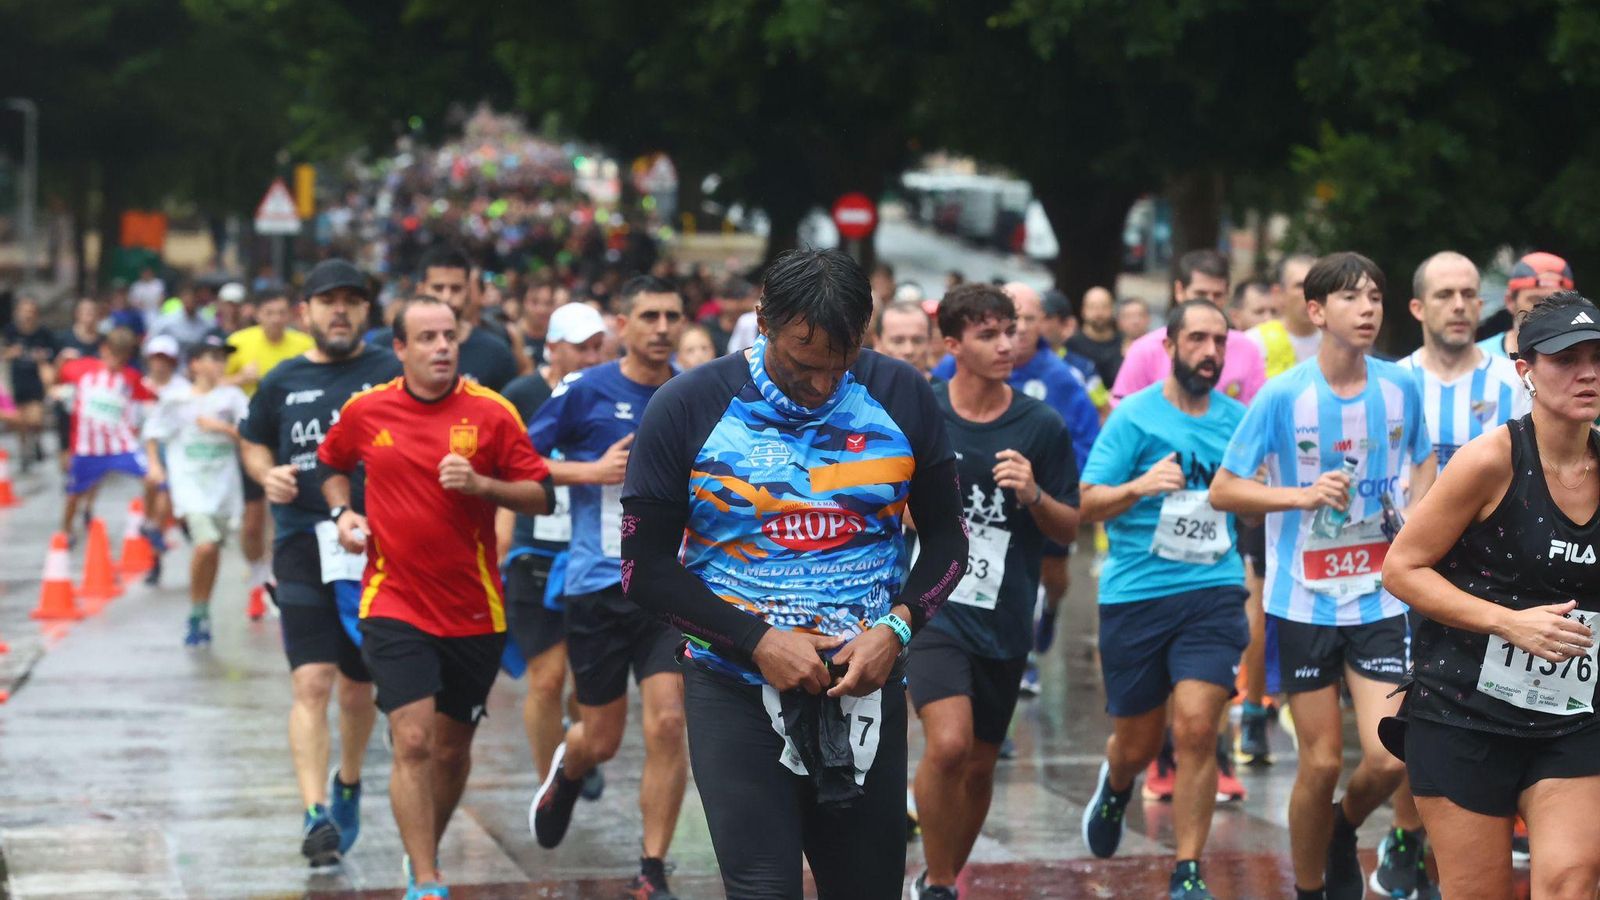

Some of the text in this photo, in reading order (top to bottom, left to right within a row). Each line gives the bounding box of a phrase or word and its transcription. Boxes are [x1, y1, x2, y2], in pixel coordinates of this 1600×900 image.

[766, 512, 862, 540] TROPS
[1325, 549, 1371, 577] 342
[1549, 539, 1597, 564] FILA
[743, 564, 805, 577] MEDIA
